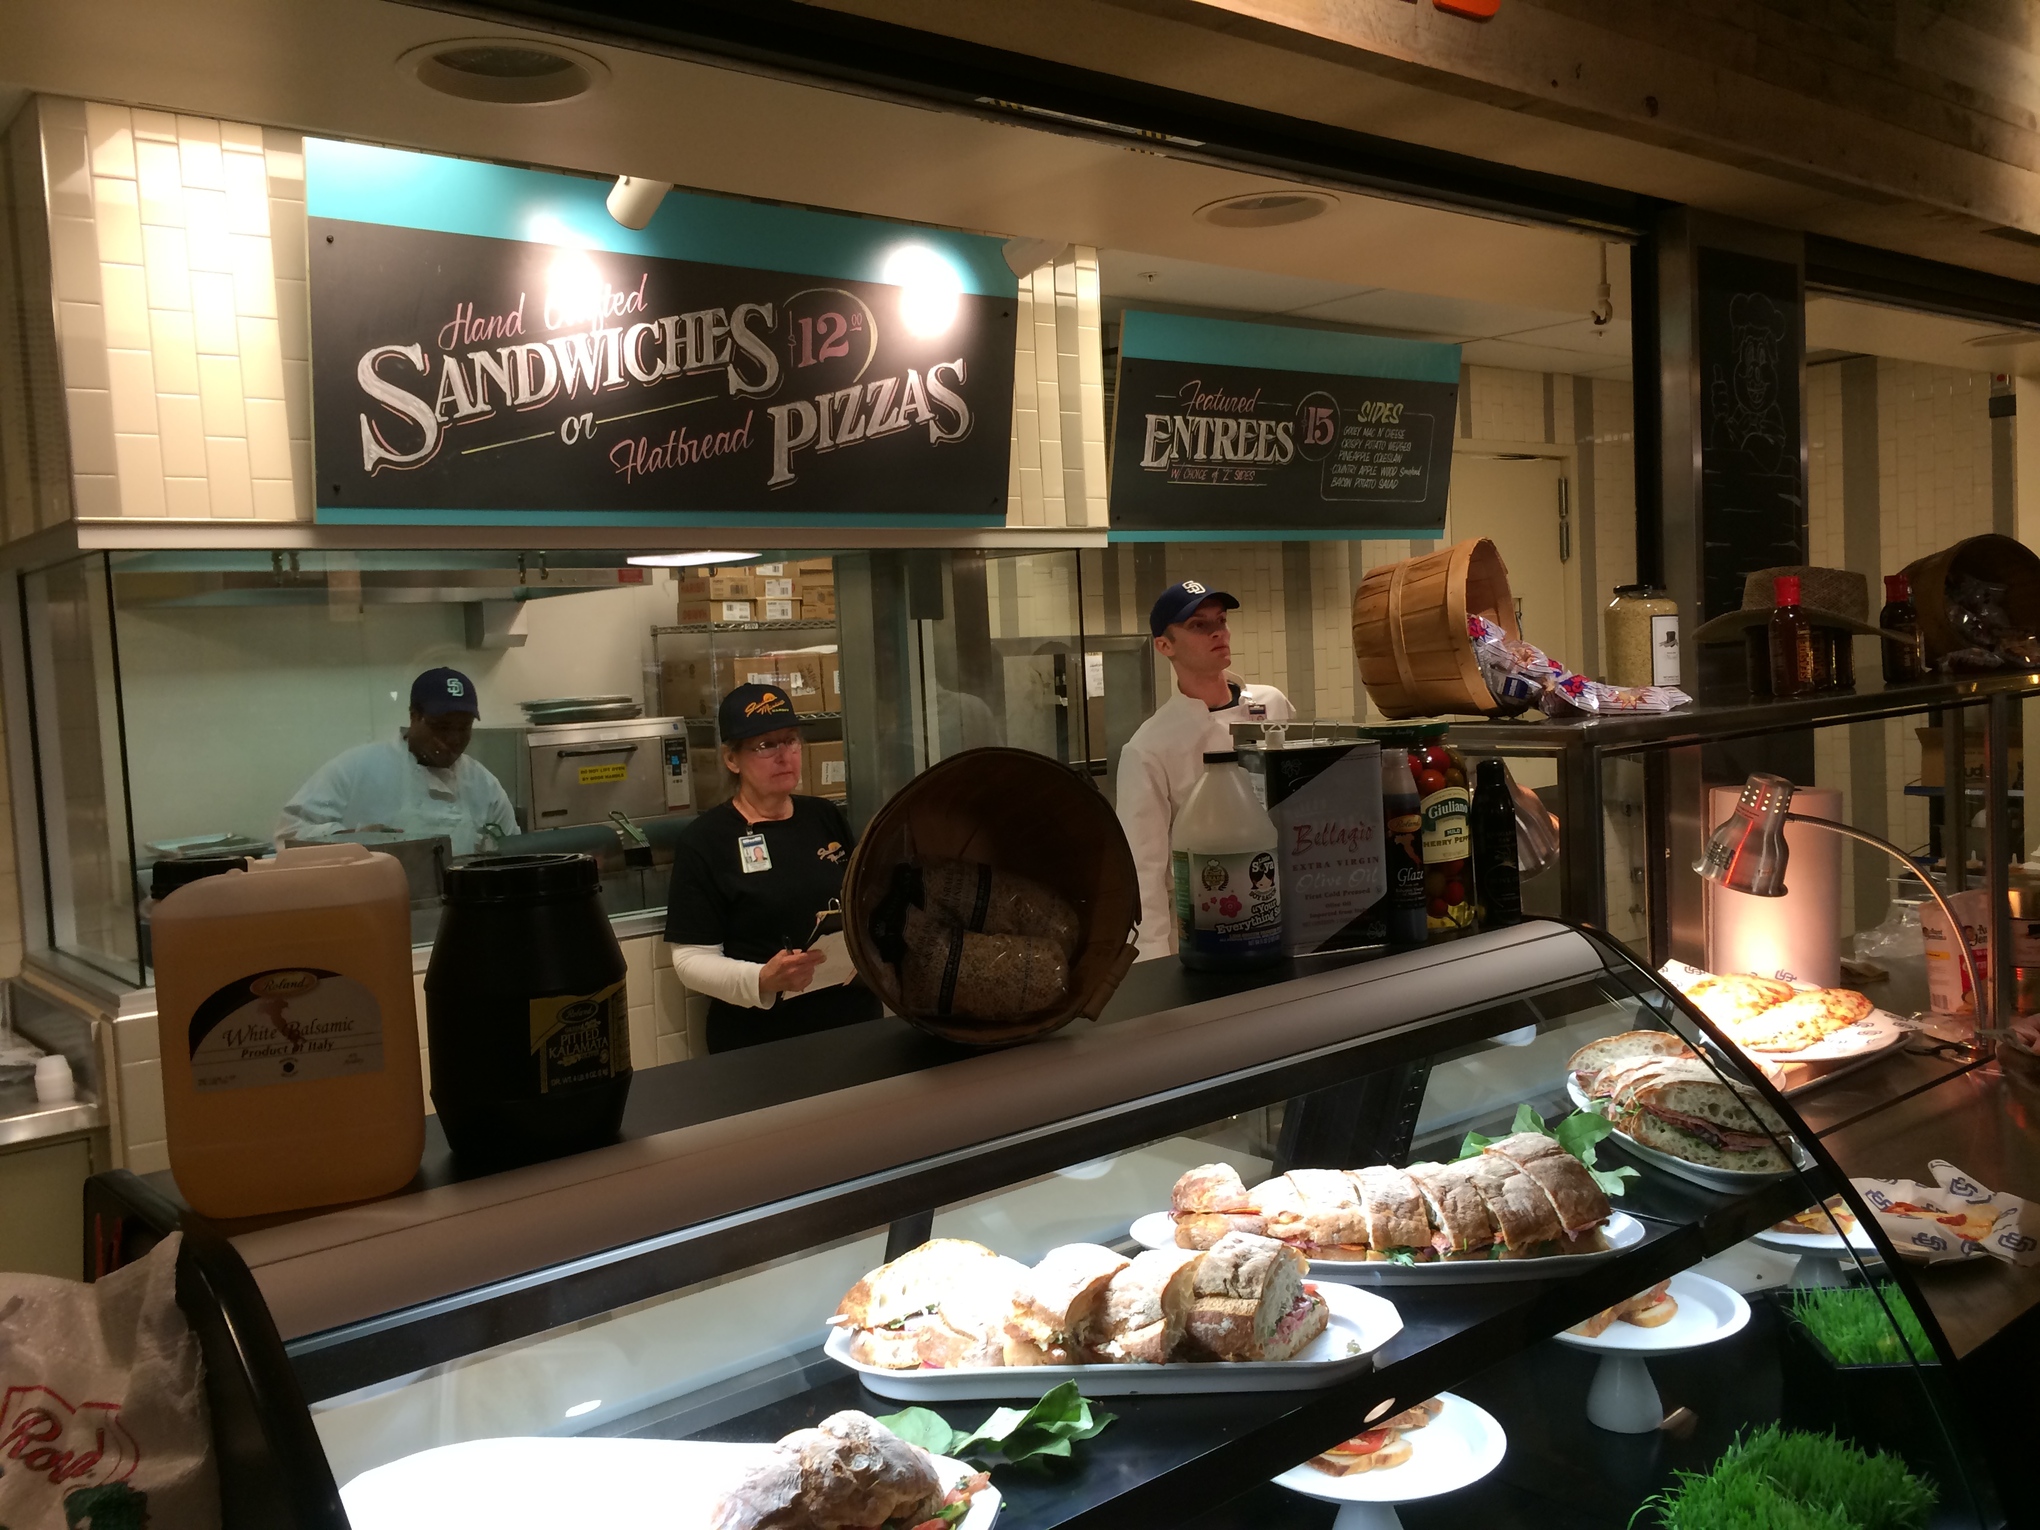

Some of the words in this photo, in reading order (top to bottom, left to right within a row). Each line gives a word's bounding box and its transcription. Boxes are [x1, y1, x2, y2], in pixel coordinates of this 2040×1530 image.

[438, 292, 526, 350] Hand
[357, 303, 782, 475] SANDWICHES
[1179, 379, 1261, 416] Featured
[1358, 401, 1403, 424] SIDES
[561, 410, 598, 445] or
[767, 359, 973, 489] PIZZAS
[1385, 428, 1406, 439] CHEESE
[609, 411, 753, 483] Flatbread
[1140, 414, 1295, 471] ENTREES
[1341, 438, 1363, 449] CRISPY
[1364, 440, 1386, 450] POTATO
[1388, 441, 1412, 452] WEDGES
[1338, 450, 1370, 462] PINEAPPLE
[1373, 453, 1403, 463] COLESLAW
[1183, 469, 1207, 480] CHOICE
[1234, 470, 1255, 481] SIDES
[1331, 463, 1358, 474] COUNTRY
[1358, 465, 1378, 476] APPLE
[1330, 476, 1352, 488] BACON
[1354, 478, 1377, 489] POTATO
[1378, 479, 1400, 489] SALAD
[1428, 800, 1468, 819] Giuliano
[1292, 821, 1374, 856] Bellagio
[1252, 861, 1275, 873] Soya
[1292, 861, 1331, 872] EXTRA
[1337, 856, 1379, 867] VIRGIN
[1296, 873, 1342, 894] Olive
[1348, 866, 1378, 888] Oil
[1305, 893, 1322, 901] First
[1342, 888, 1371, 897] Pressed
[1215, 909, 1275, 935] Everything
[263, 976, 307, 992] Roland
[222, 1022, 278, 1047] White
[282, 1016, 355, 1040] Balsamic
[561, 1027, 600, 1046] PITTED
[241, 1045, 288, 1059] Product
[307, 1038, 335, 1052] Italy
[549, 1036, 609, 1059] KALAMATA
